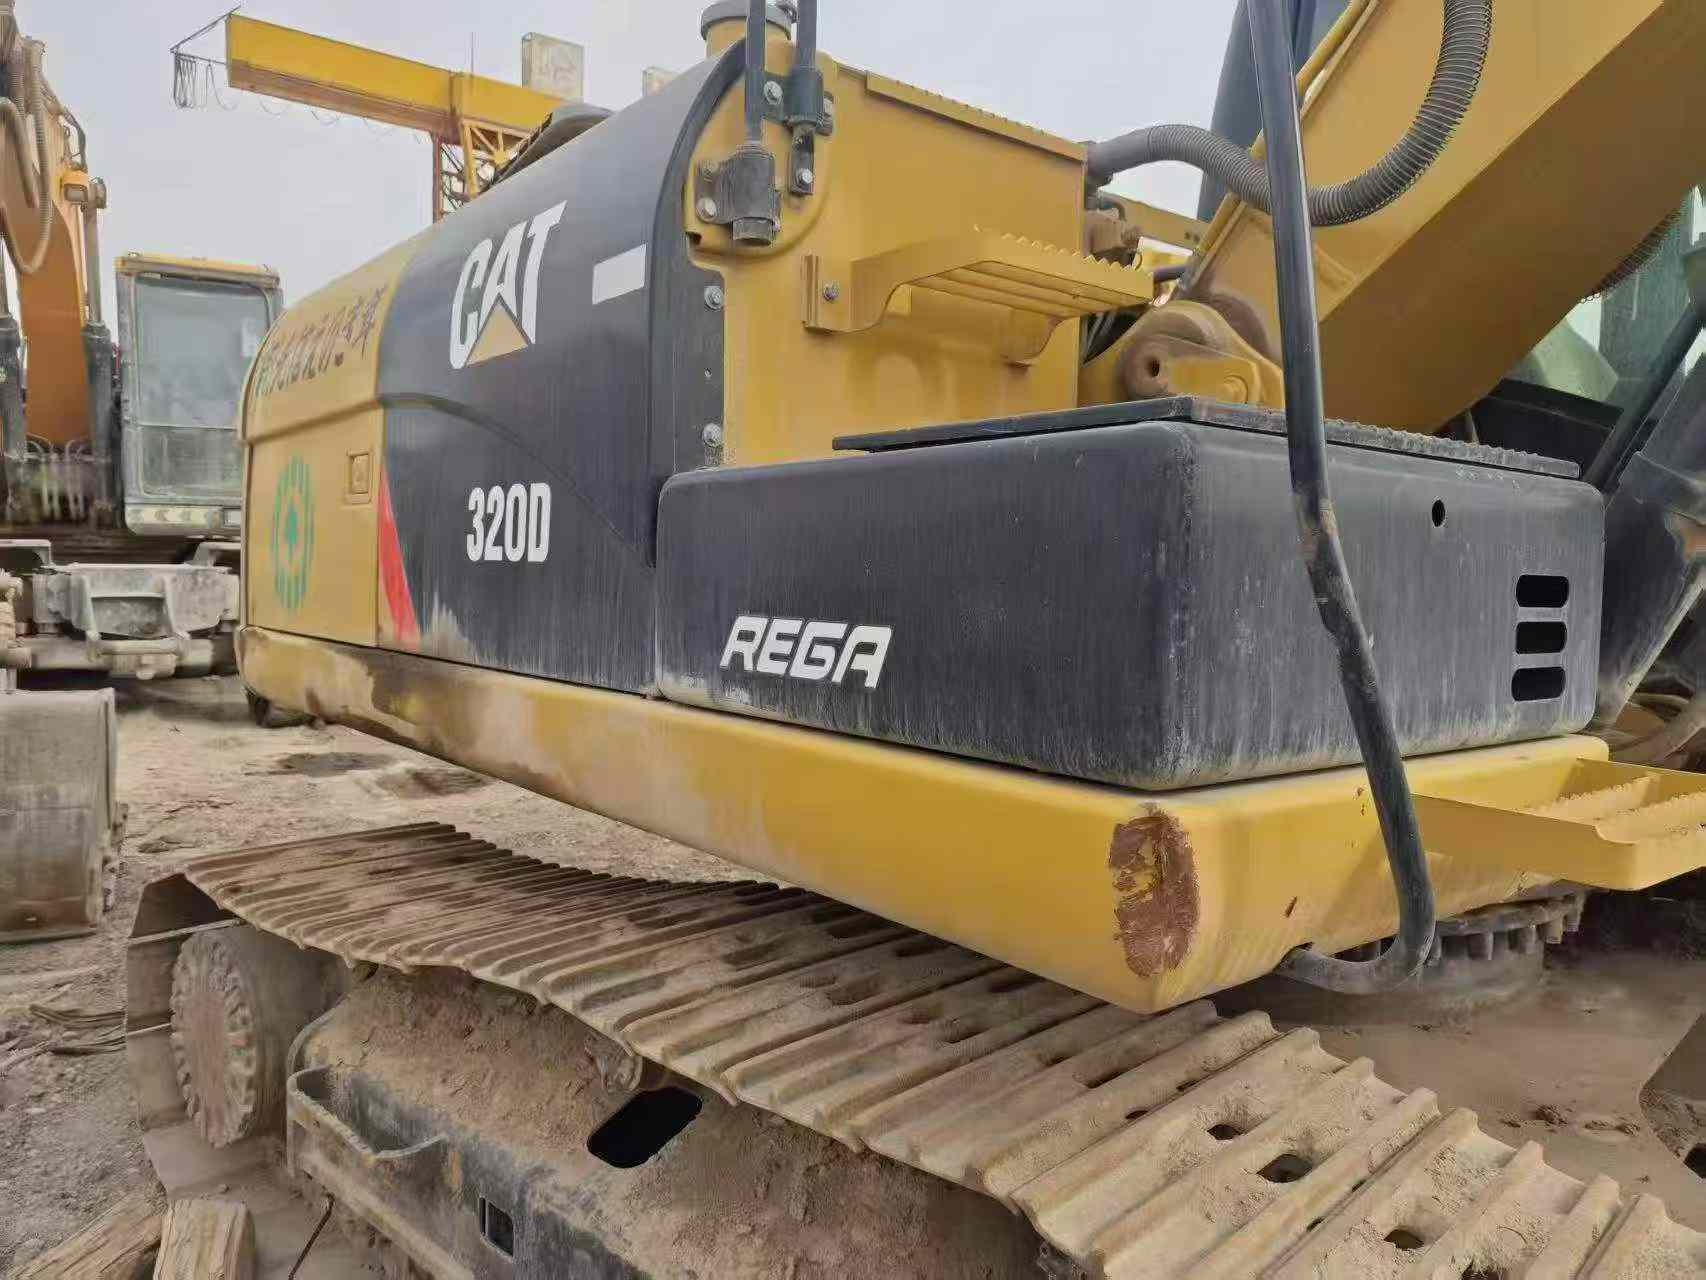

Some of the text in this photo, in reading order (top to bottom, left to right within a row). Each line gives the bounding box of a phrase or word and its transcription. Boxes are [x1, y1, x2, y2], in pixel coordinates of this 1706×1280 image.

[450, 201, 567, 369] CAT
[466, 482, 551, 562] 320D
[720, 616, 892, 689] REGA
